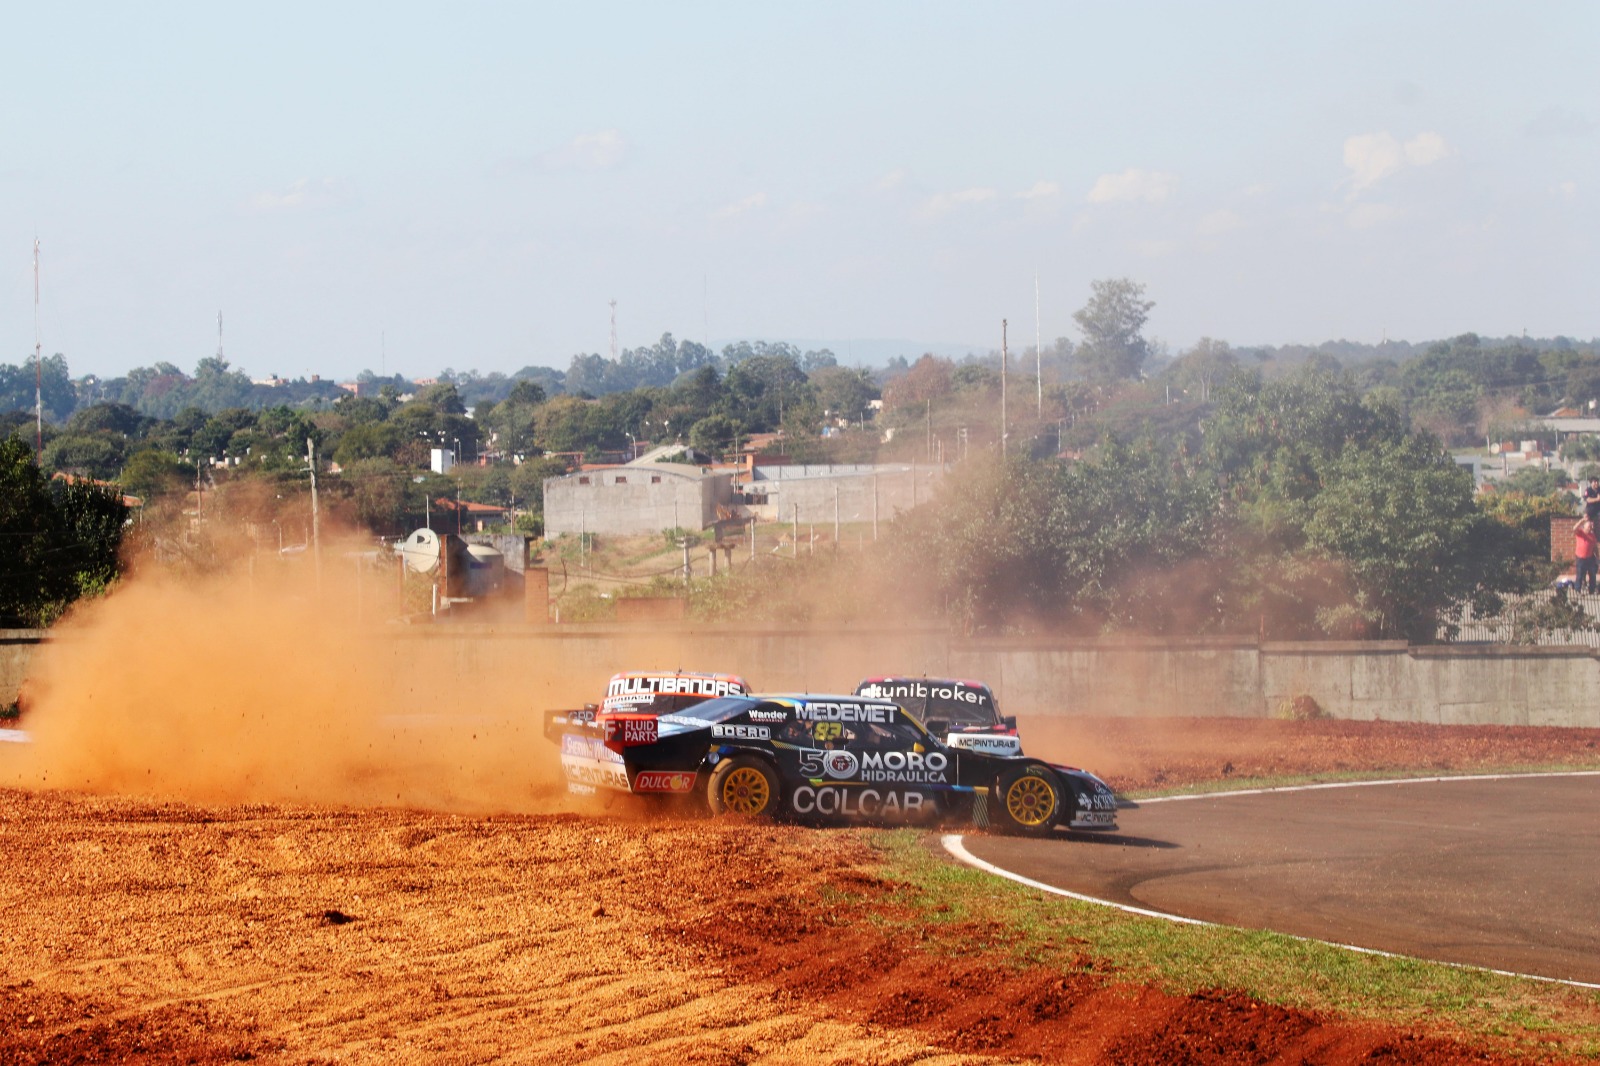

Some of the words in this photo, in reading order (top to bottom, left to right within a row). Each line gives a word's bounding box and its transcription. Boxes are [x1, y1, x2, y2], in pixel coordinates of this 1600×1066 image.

[607, 677, 741, 699] MULTIBANDAS
[882, 682, 987, 706] unibroker
[748, 709, 788, 720] Wander
[794, 702, 897, 724] MEDEMET
[625, 720, 655, 732] FLUID
[712, 725, 769, 740] BOERO
[625, 731, 658, 742] PARTS
[861, 751, 948, 772] MORO
[861, 770, 948, 784] HIDRAULICA
[793, 785, 925, 816] COLCAR
